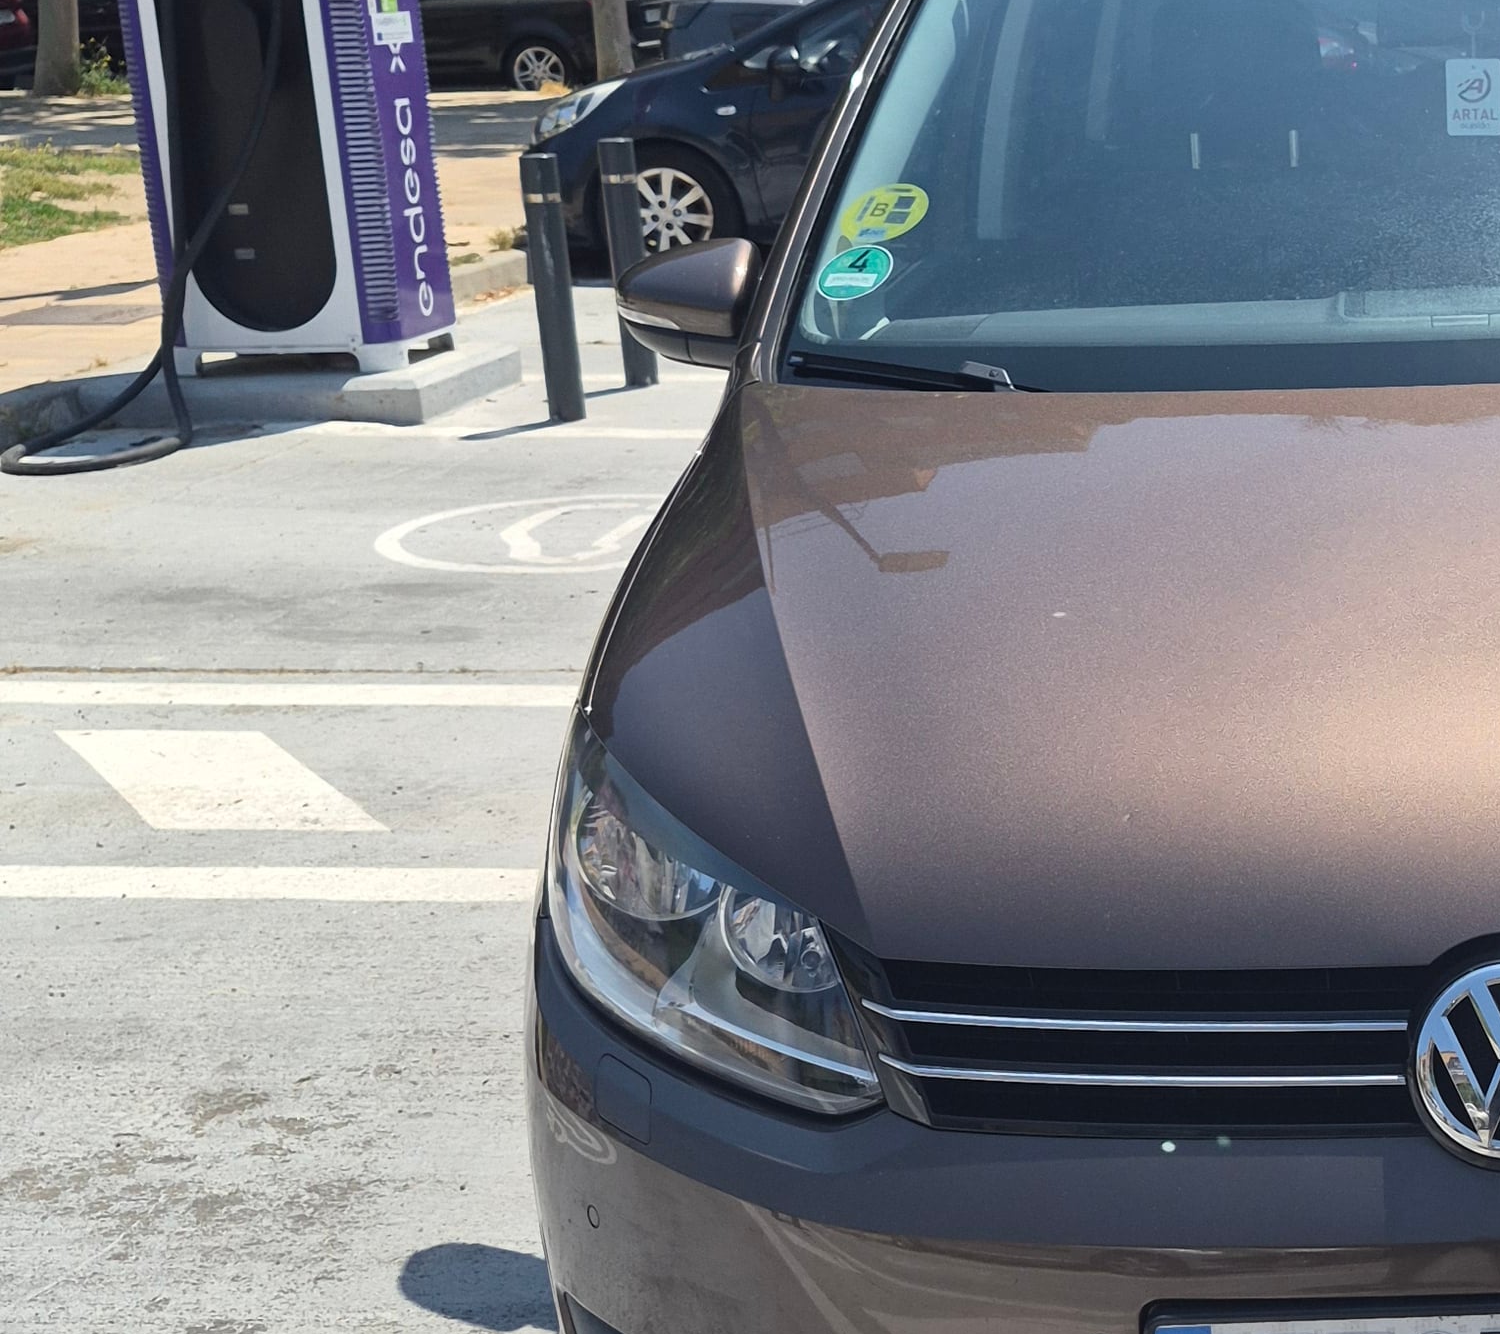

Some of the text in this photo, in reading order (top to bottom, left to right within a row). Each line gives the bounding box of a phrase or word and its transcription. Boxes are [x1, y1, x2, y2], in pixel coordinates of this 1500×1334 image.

[1452, 108, 1499, 121] ARTAL
[393, 96, 434, 317] endesa
[870, 203, 889, 217] B
[848, 249, 871, 273] 4
